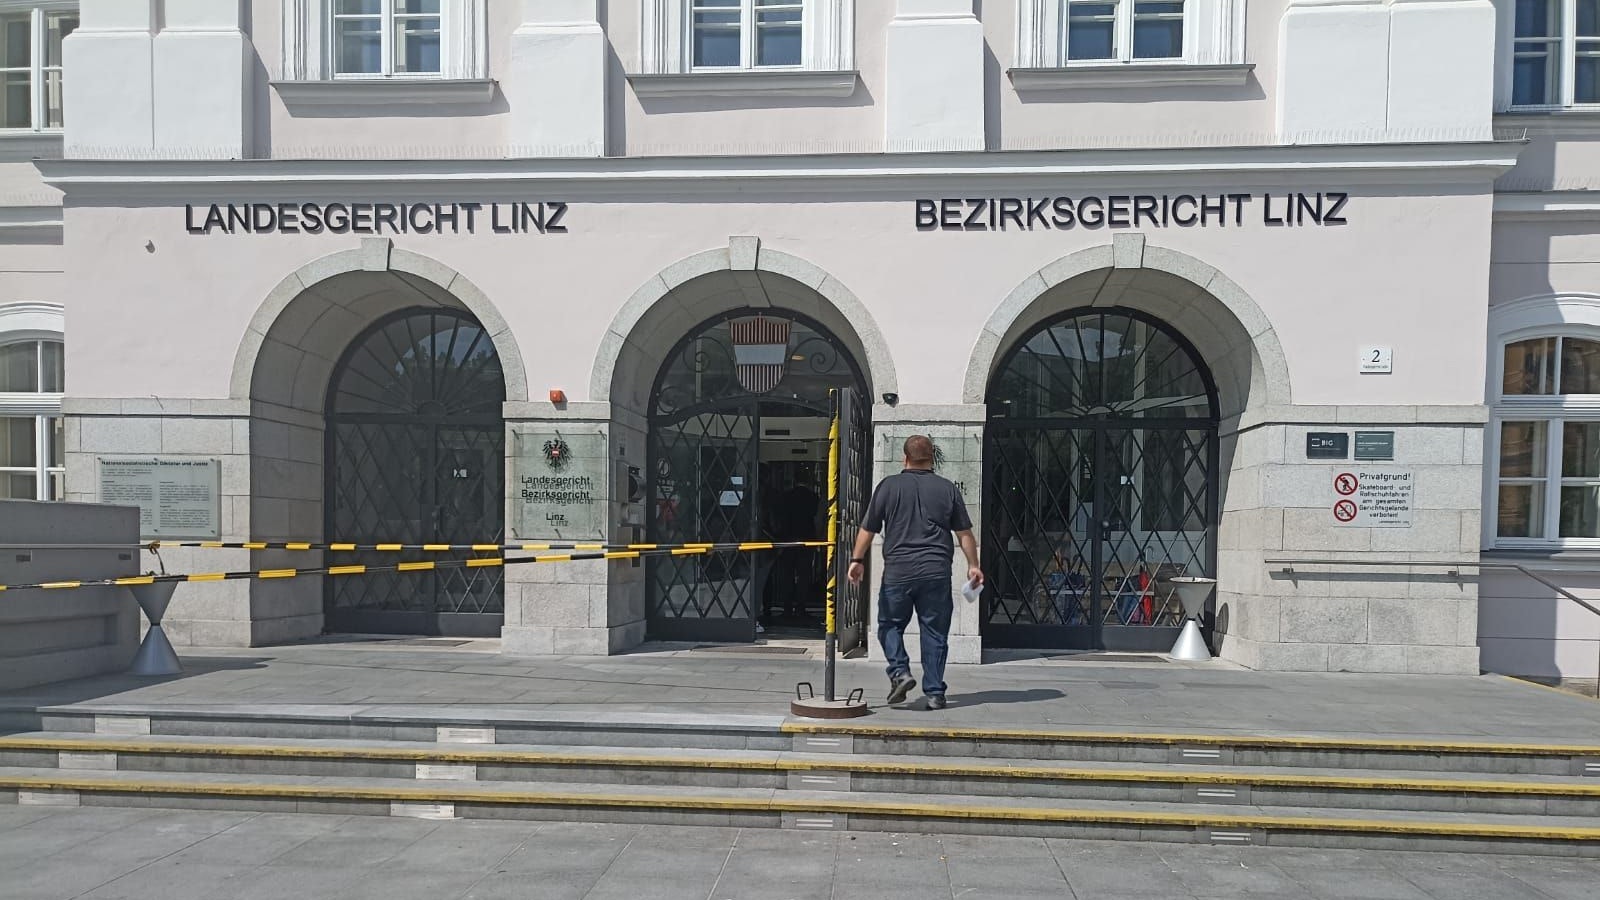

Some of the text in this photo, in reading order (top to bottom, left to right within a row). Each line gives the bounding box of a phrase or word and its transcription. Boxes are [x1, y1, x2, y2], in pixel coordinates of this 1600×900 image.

[914, 192, 1349, 229] BEZIRKSGERICHT LINZ
[185, 201, 568, 233] LANDESGERICHT LINZ
[1371, 349, 1381, 363] 2
[521, 474, 590, 486] Landesgericht
[1359, 472, 1411, 482] Privatgrund!
[521, 489, 590, 500] Bezirksgericht
[546, 512, 565, 521] Linz
